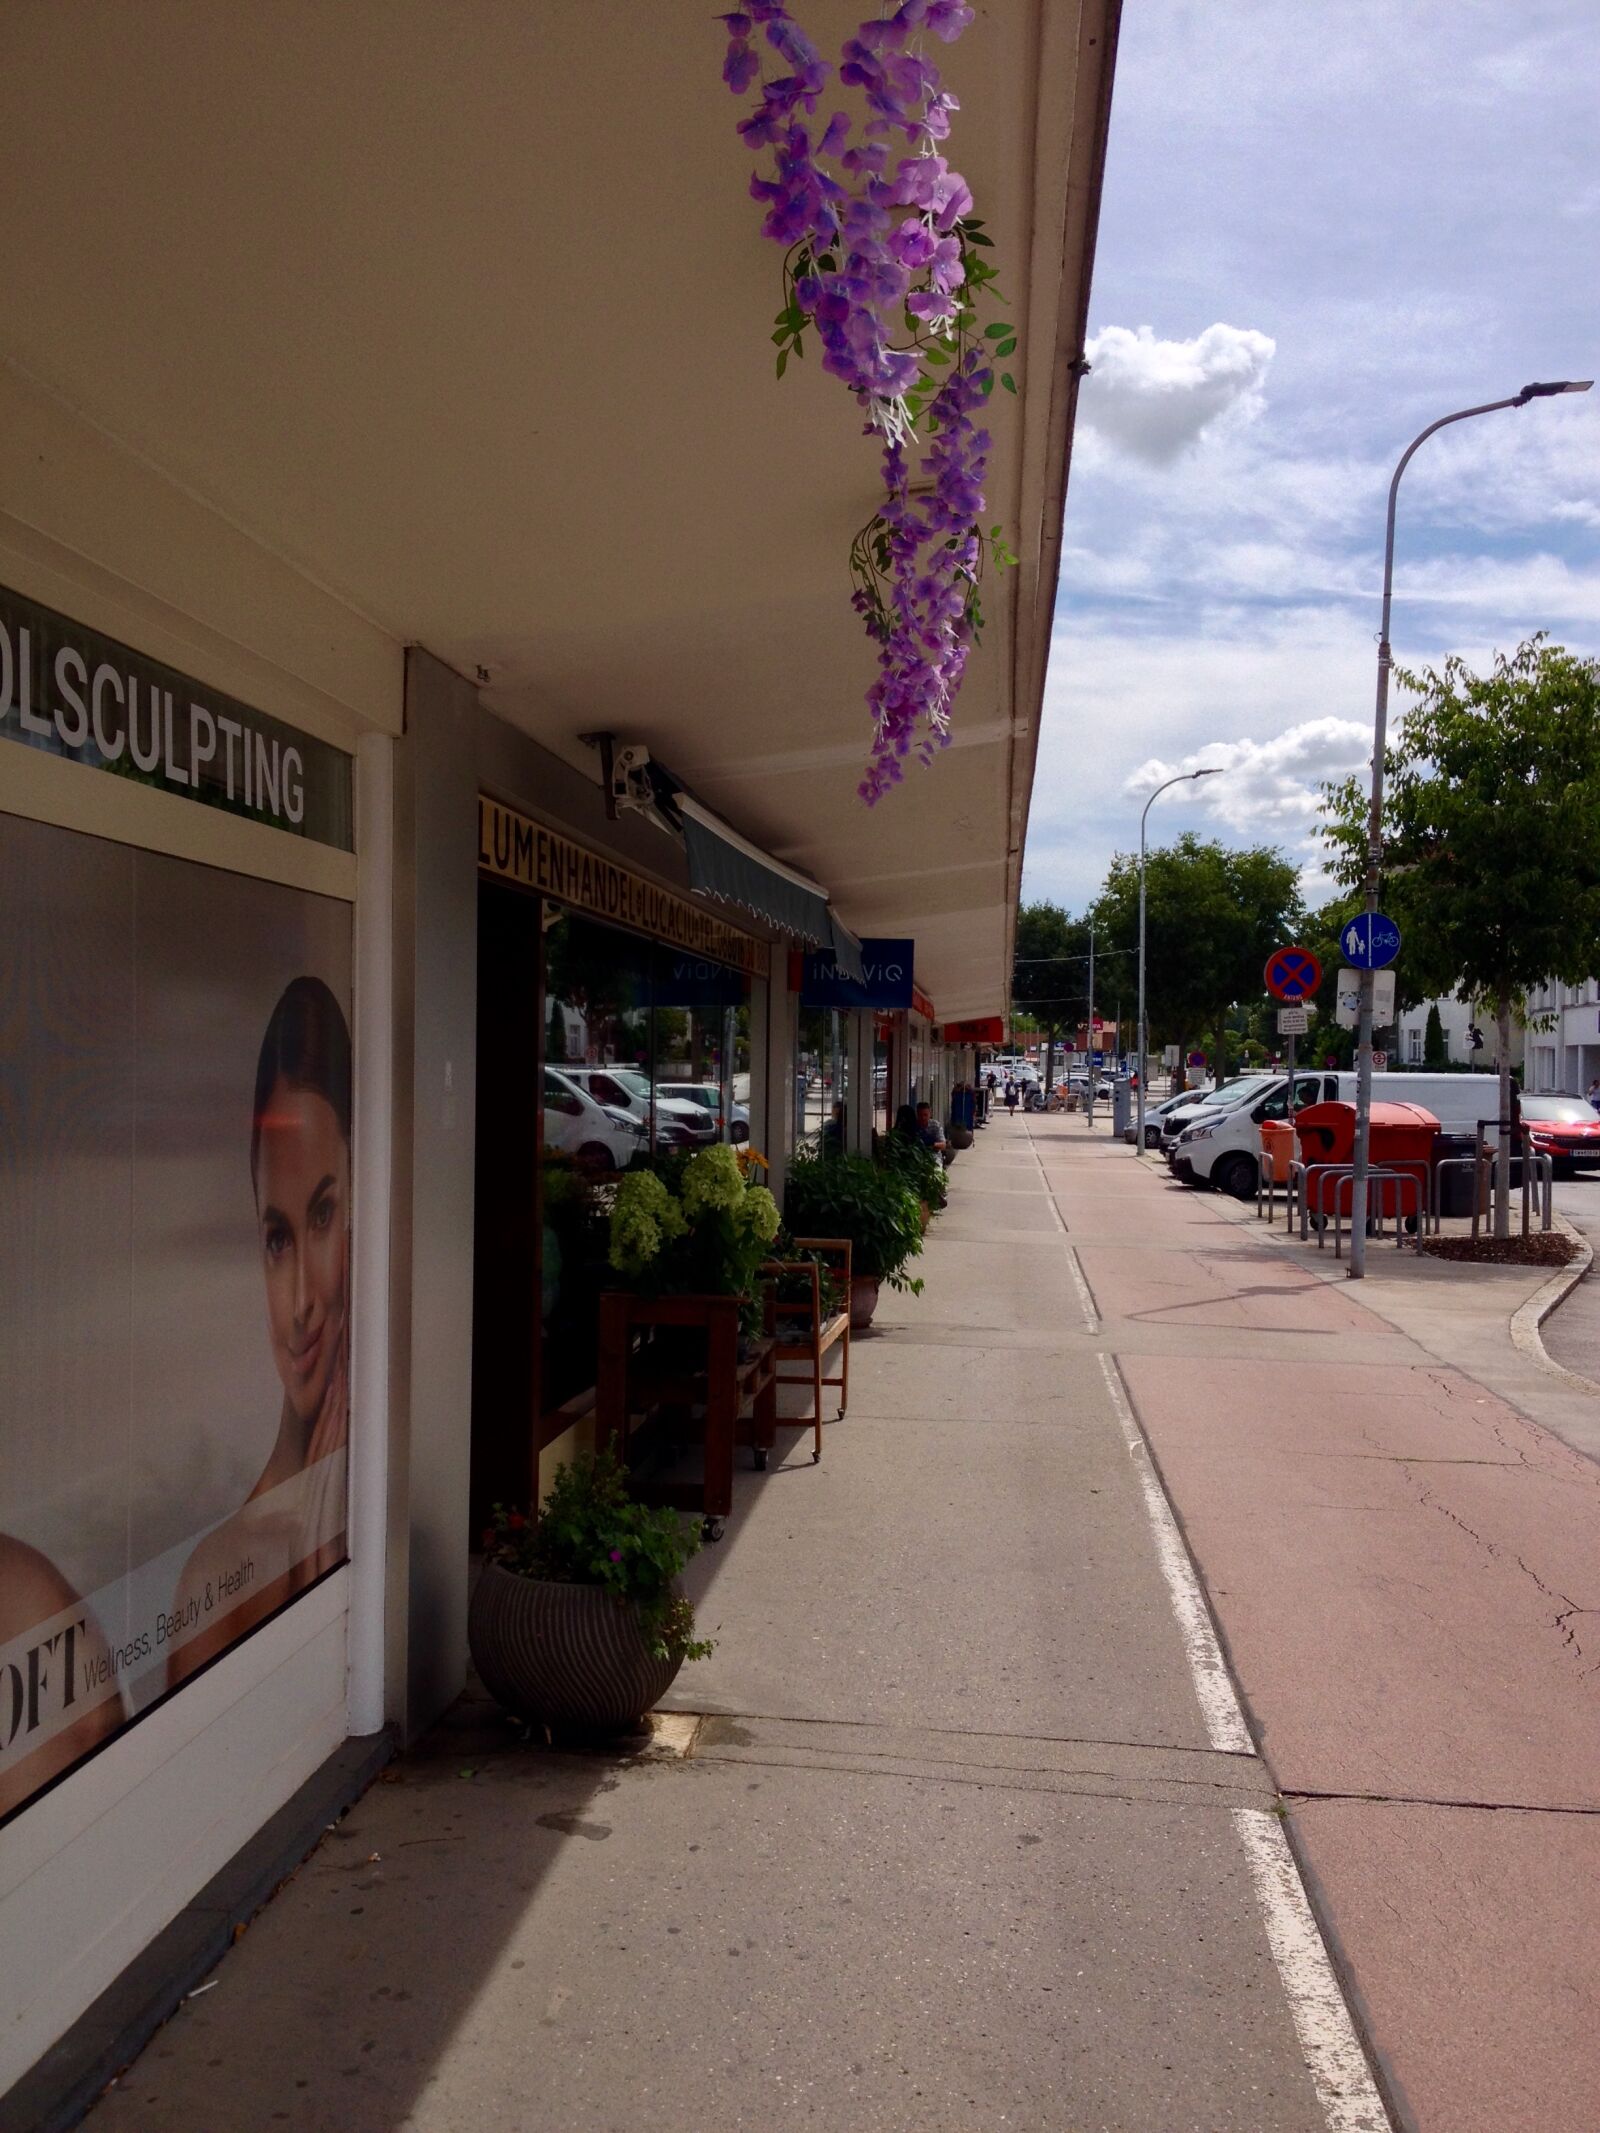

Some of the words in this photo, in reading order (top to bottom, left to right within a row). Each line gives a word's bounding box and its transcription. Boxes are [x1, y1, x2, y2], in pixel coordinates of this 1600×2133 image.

[84, 1632, 152, 1692] Wellness,
[156, 1598, 201, 1646] Beauty
[204, 1582, 214, 1612] &
[218, 1556, 255, 1602] Health
